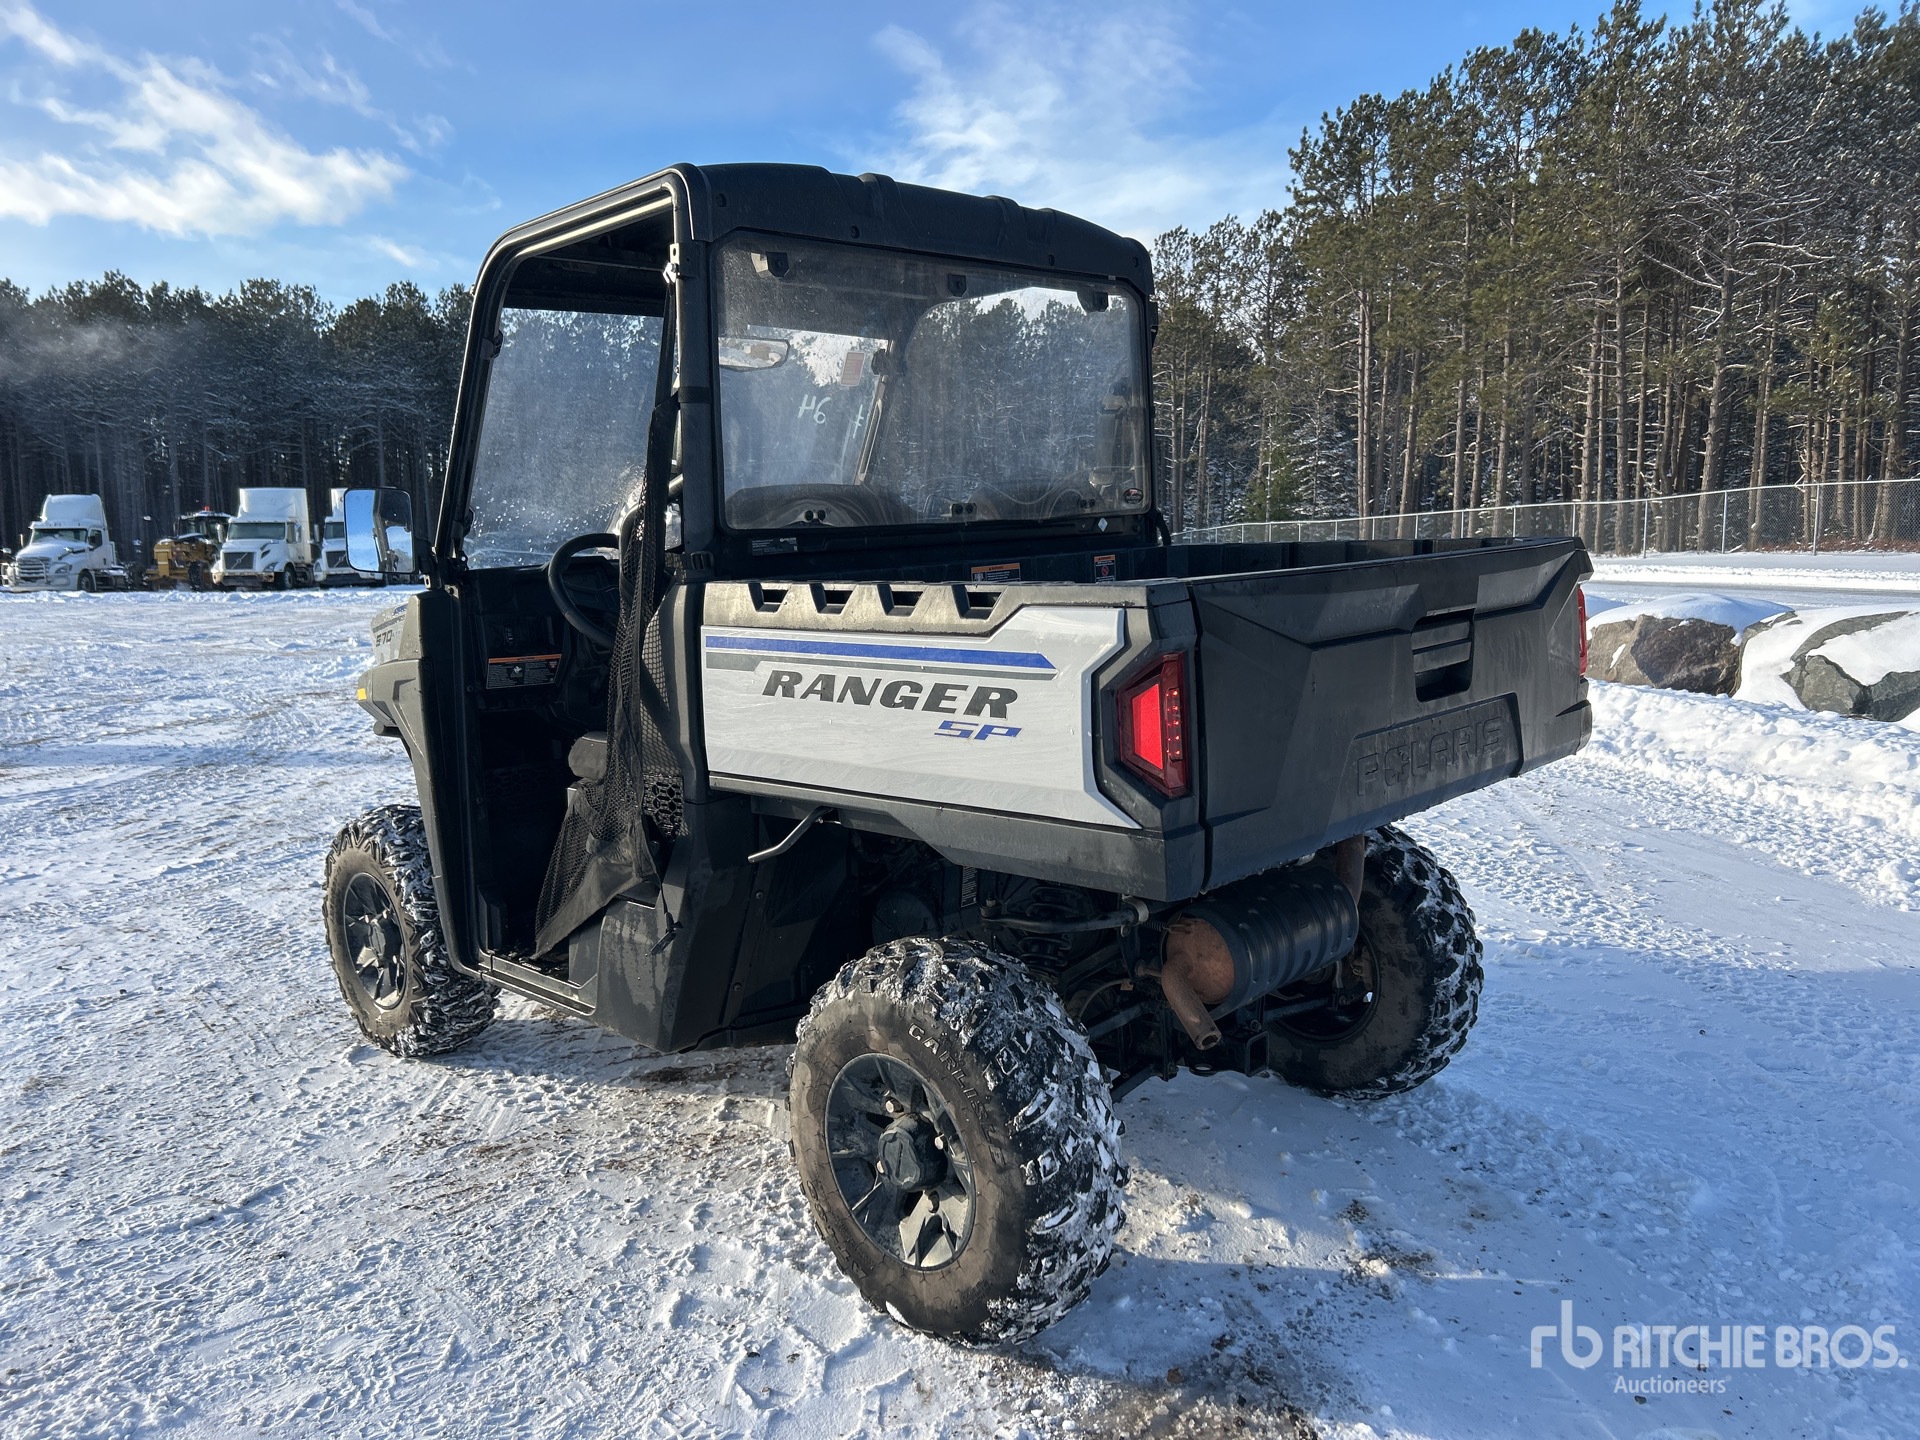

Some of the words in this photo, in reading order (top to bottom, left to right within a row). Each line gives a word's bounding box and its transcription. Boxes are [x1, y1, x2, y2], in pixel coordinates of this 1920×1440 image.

[761, 669, 1019, 720] RANGER
[934, 719, 1023, 741] SP
[1356, 716, 1502, 797] POLARIS
[908, 1022, 1007, 1166] CARLISLE
